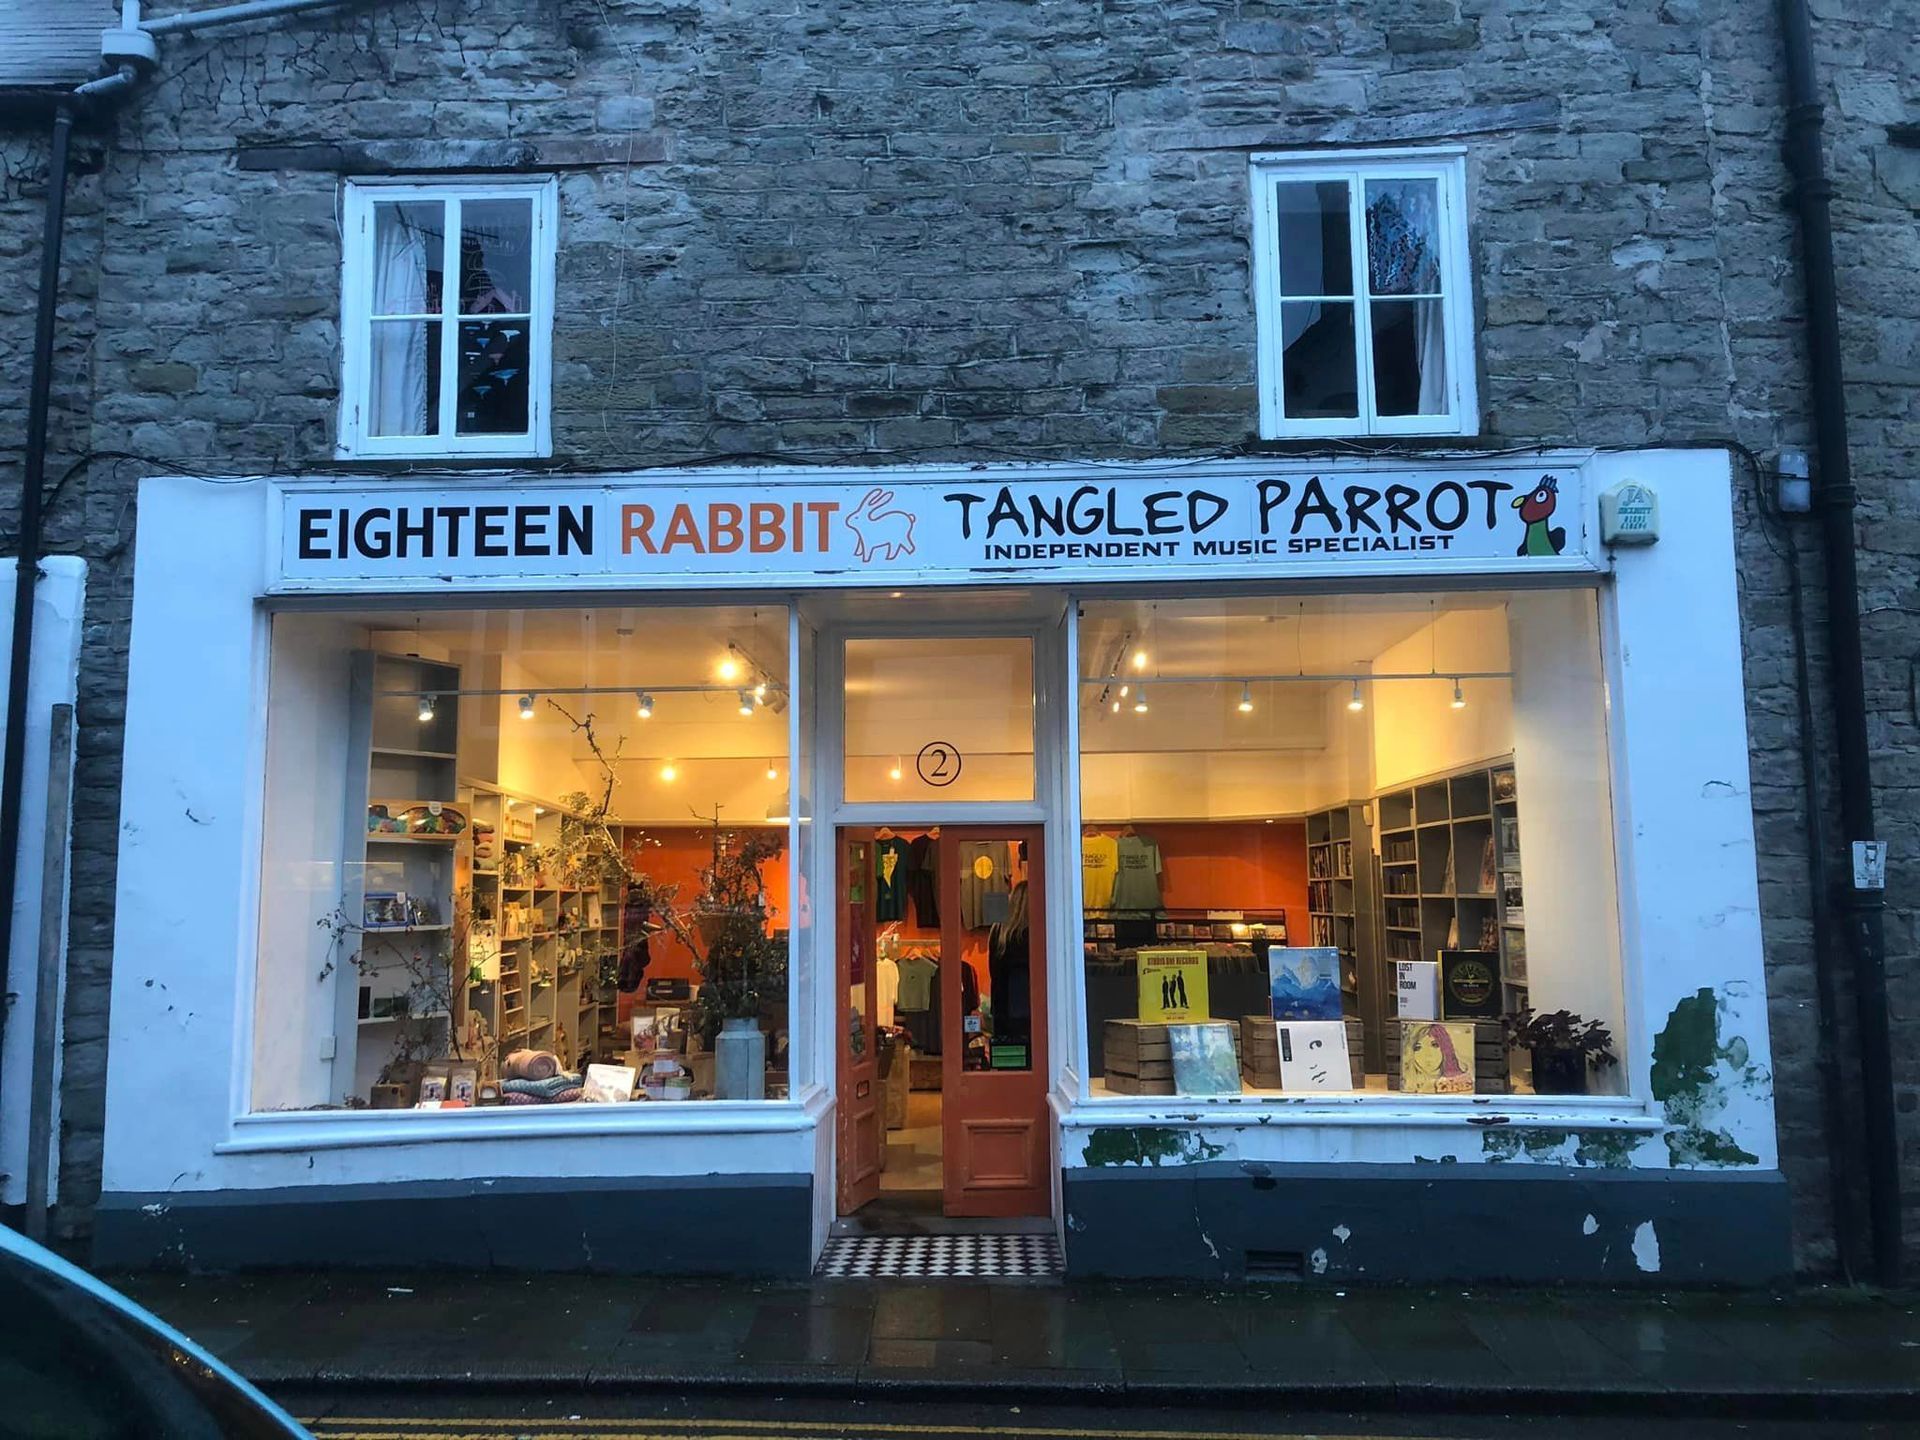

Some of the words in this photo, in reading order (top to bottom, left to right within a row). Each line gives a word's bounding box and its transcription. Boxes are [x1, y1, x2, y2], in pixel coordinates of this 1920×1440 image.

[943, 486, 1229, 540] TANGLED
[1256, 476, 1514, 535] PARROT
[299, 505, 593, 559] EIGHTEEN
[621, 502, 840, 554] RABBIT
[984, 541, 1180, 560] INDEPENDENT
[1193, 539, 1277, 556] MUSIC
[1288, 535, 1454, 553] SPECIALIST
[931, 749, 948, 777] 2
[1398, 963, 1413, 971] LOST
[1399, 972, 1406, 980] IN
[1399, 980, 1417, 990] ROOM
